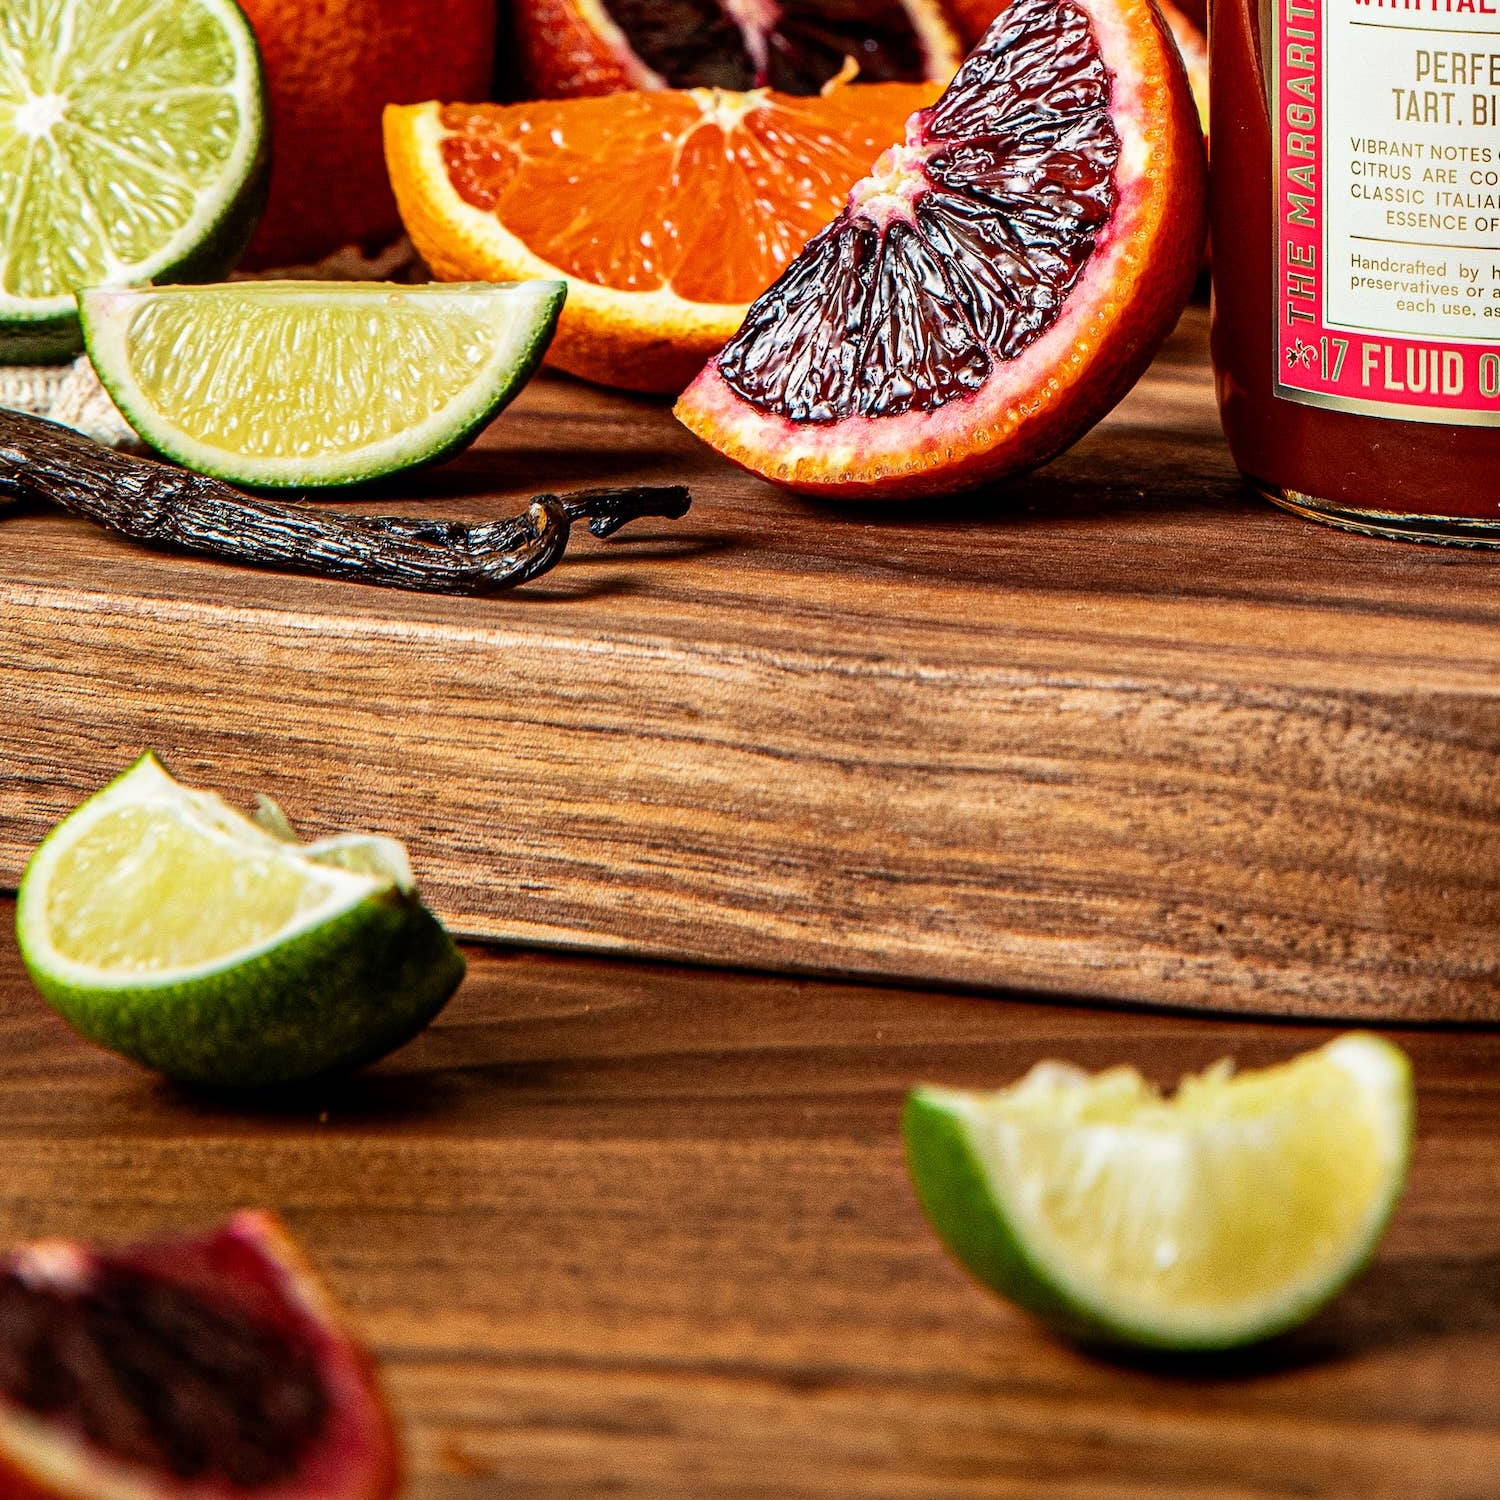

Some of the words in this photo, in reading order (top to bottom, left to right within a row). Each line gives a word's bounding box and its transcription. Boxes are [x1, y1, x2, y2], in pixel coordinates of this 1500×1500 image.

[1350, 137, 1424, 159] VIBRANT
[1430, 145, 1492, 163] NOTES
[1351, 160, 1412, 180] CITRUS
[1423, 168, 1457, 184] ARE
[1350, 184, 1425, 204] CLASSIC
[1387, 210, 1468, 231] ESSENCE
[1475, 217, 1500, 232] OF
[1351, 254, 1447, 277] Handcrafted
[1459, 263, 1480, 283] by
[1286, 240, 1315, 326] THE
[1351, 274, 1459, 297] preservatives
[1466, 286, 1485, 298] or
[1396, 299, 1436, 314] each
[1320, 336, 1349, 382] 17
[1361, 342, 1464, 395] FLUID
